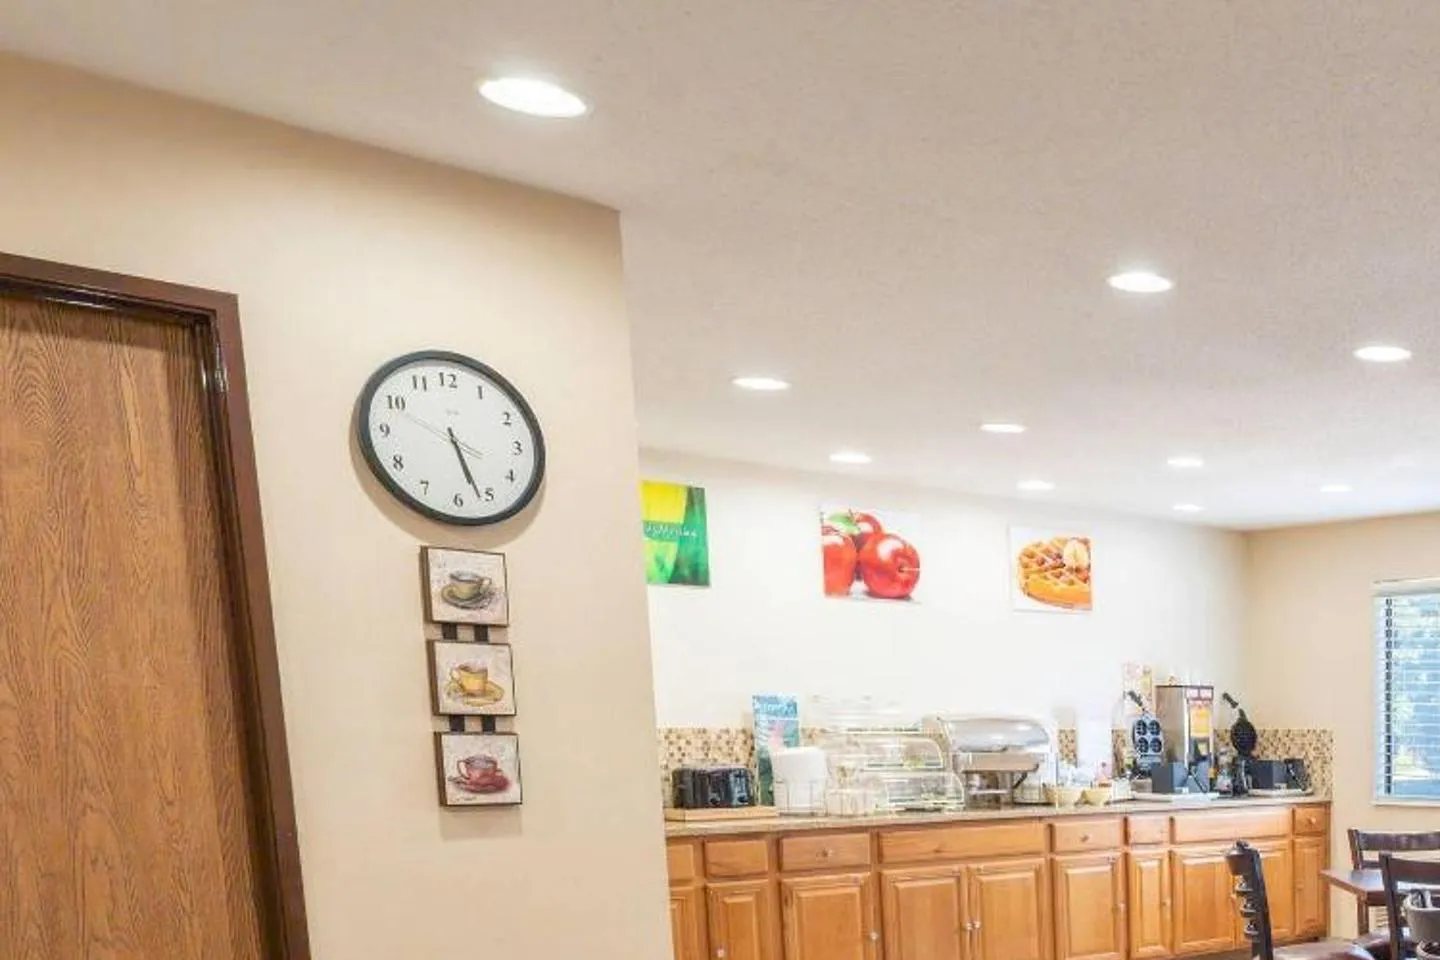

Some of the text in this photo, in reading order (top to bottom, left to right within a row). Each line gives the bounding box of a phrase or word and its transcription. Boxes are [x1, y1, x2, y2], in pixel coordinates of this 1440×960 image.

[412, 374, 428, 392] 11
[439, 371, 458, 389] 12
[477, 384, 484, 400] 1
[386, 394, 406, 411] 10
[502, 411, 512, 427] 2
[379, 422, 391, 438] 9
[513, 440, 523, 456] 3
[392, 454, 404, 471] 8
[505, 468, 516, 484] 4
[420, 479, 430, 496] 7
[484, 487, 495, 503] 5
[453, 493, 464, 508] 6
